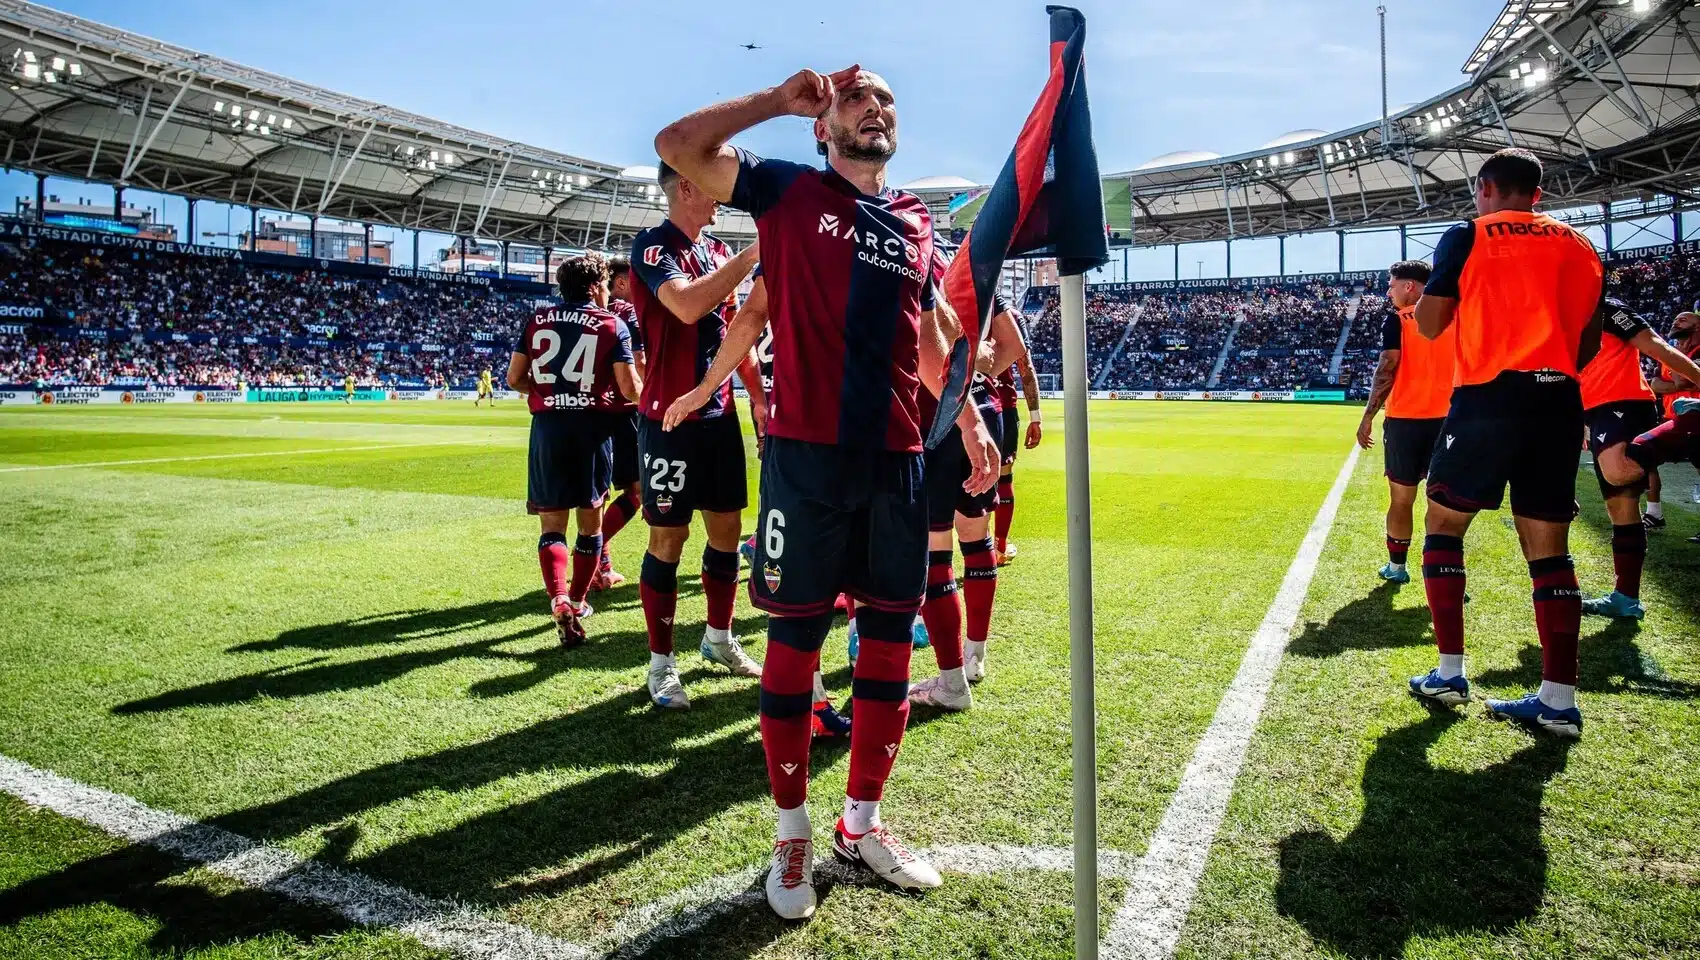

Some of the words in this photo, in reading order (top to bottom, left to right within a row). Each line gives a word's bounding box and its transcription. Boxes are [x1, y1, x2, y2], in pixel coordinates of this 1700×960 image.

[156, 242, 174, 252] DE
[818, 213, 927, 270] MARCOS
[1618, 244, 1674, 260] TRIUNFO
[470, 276, 490, 286] 1909
[1098, 284, 1110, 292] EN
[1114, 283, 1132, 291] LAS
[1135, 281, 1175, 290] BARRAS
[1252, 276, 1265, 285] DE
[535, 310, 604, 331] C.ÁLVAREZ
[532, 329, 598, 393] 24
[1534, 373, 1566, 382] Telecom
[258, 391, 296, 402] LALIGA
[650, 457, 687, 492] 23
[765, 508, 786, 559] 6
